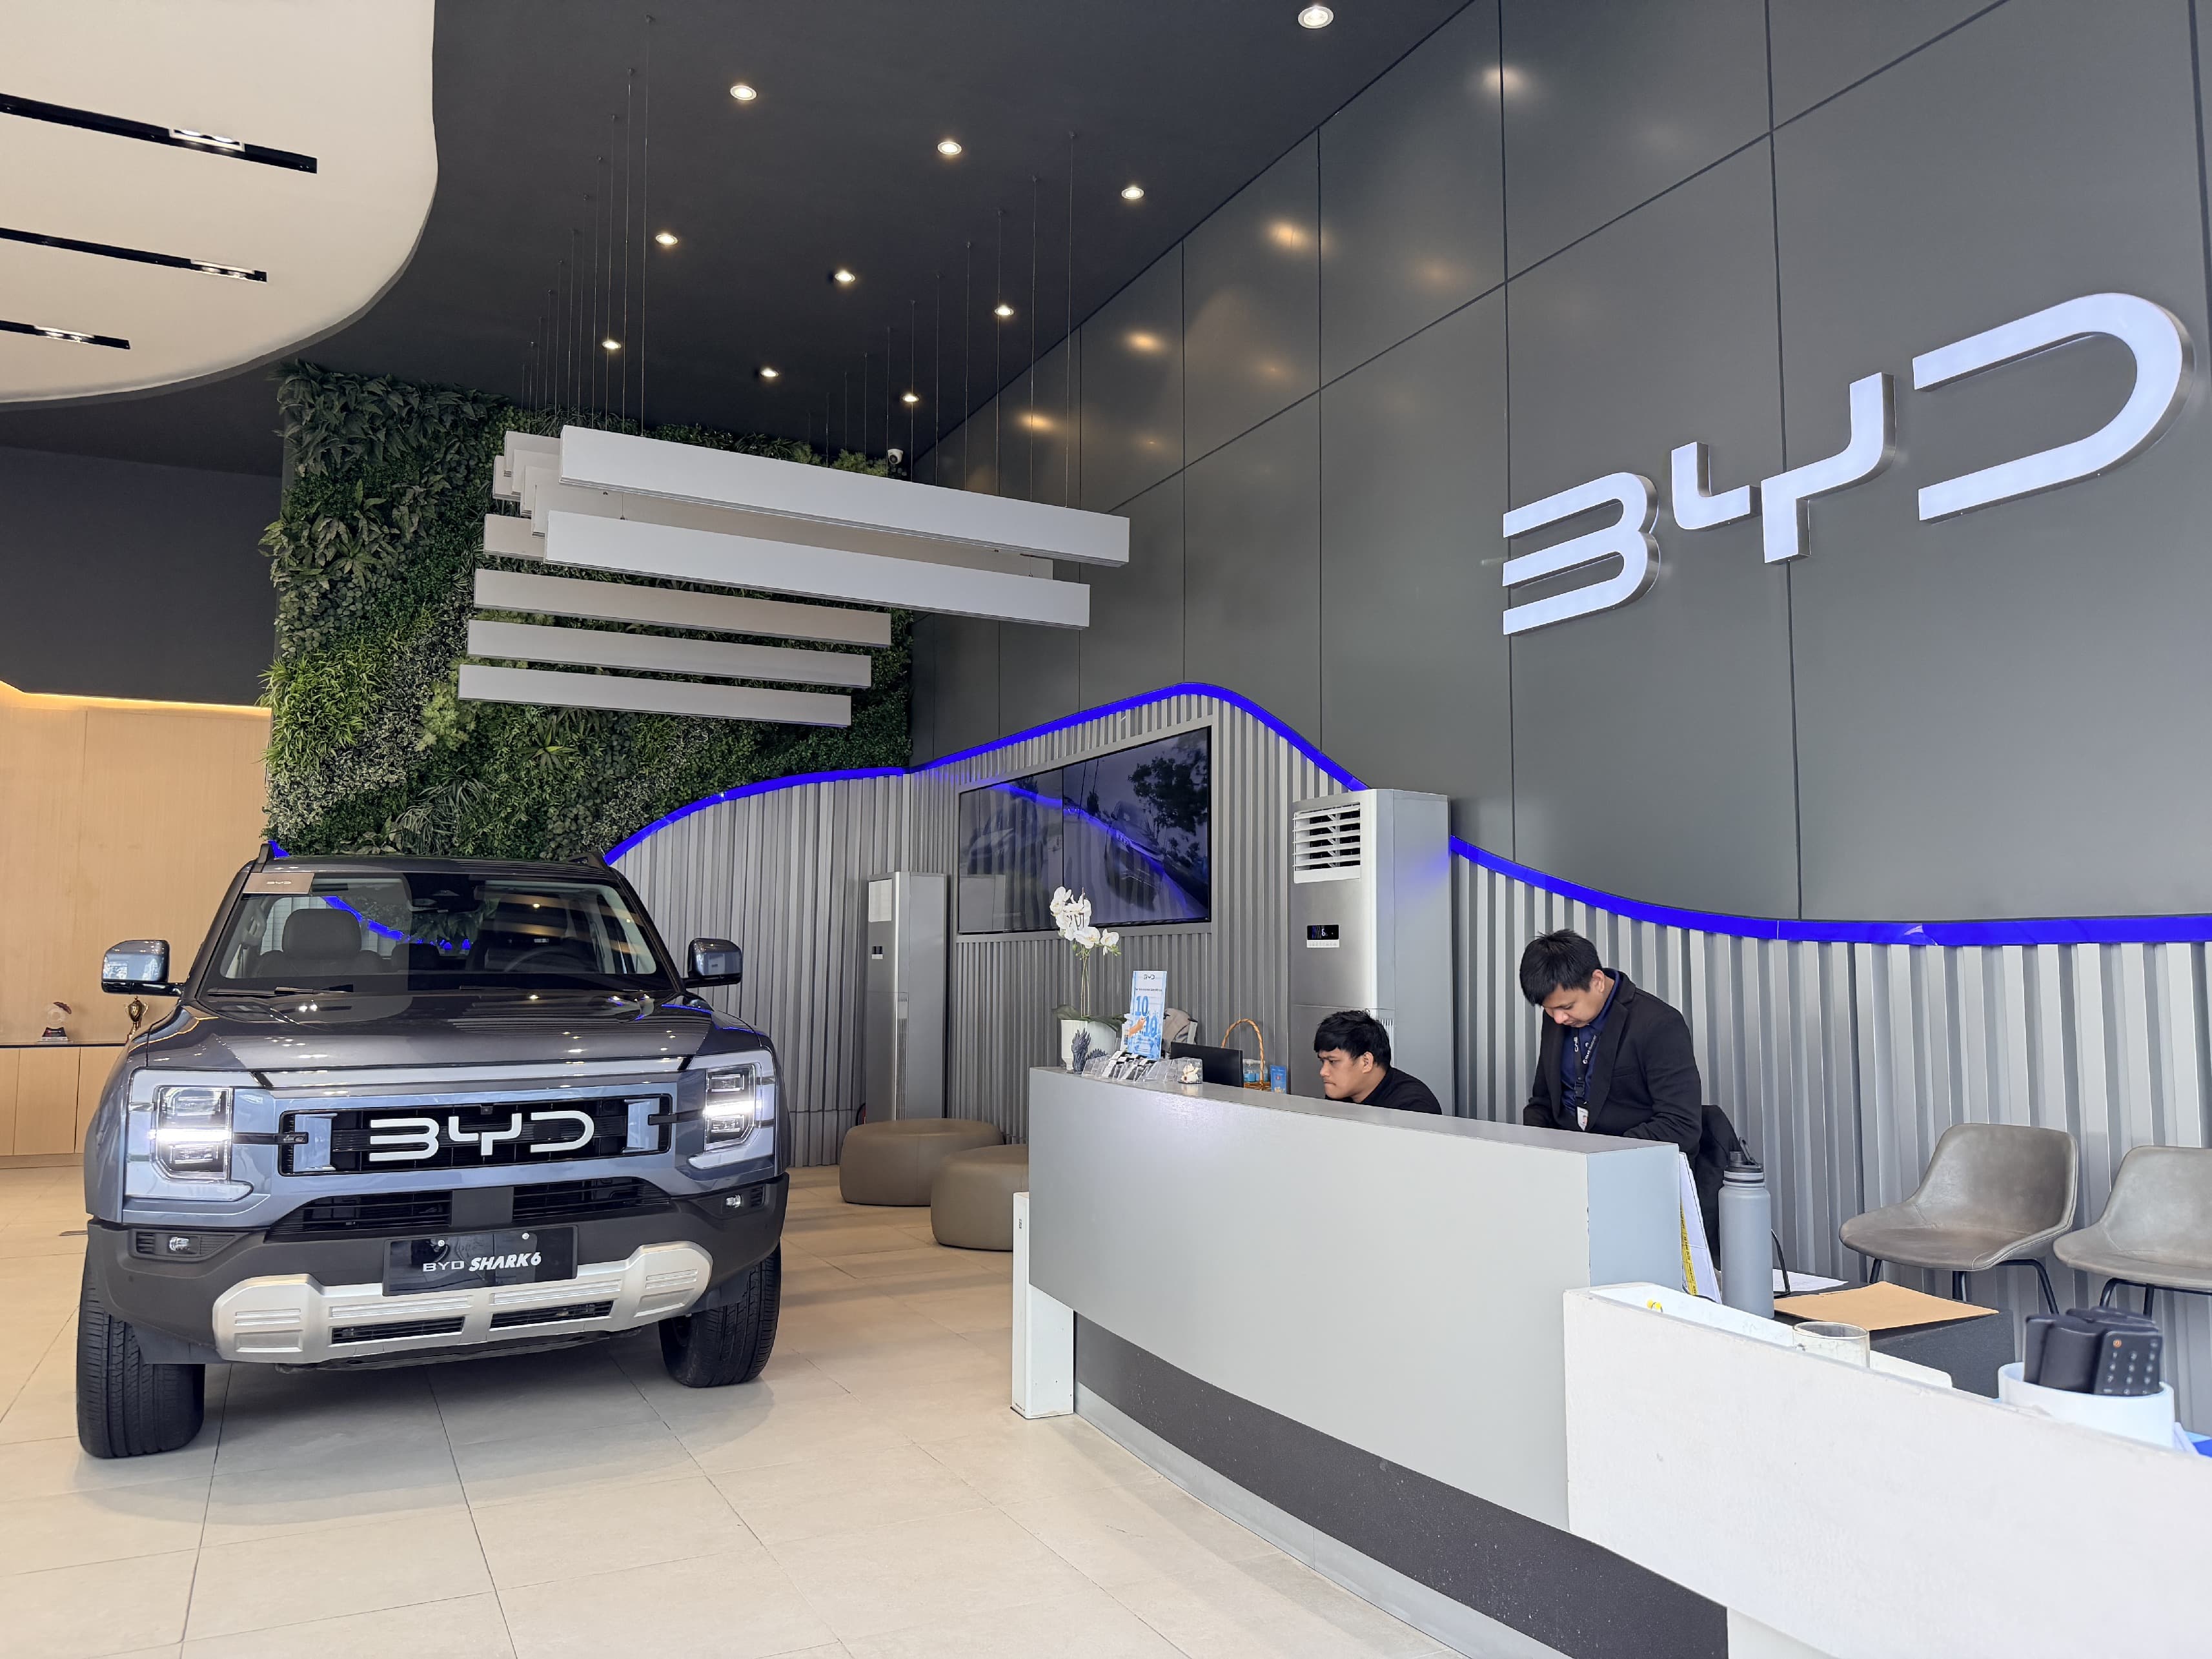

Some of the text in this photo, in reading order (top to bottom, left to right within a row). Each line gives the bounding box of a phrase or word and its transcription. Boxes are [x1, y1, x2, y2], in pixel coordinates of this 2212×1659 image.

[1503, 292, 2192, 636] BYD
[1135, 995, 1149, 1017] 10
[369, 1110, 594, 1161] BYD
[423, 1261, 465, 1272] BYD
